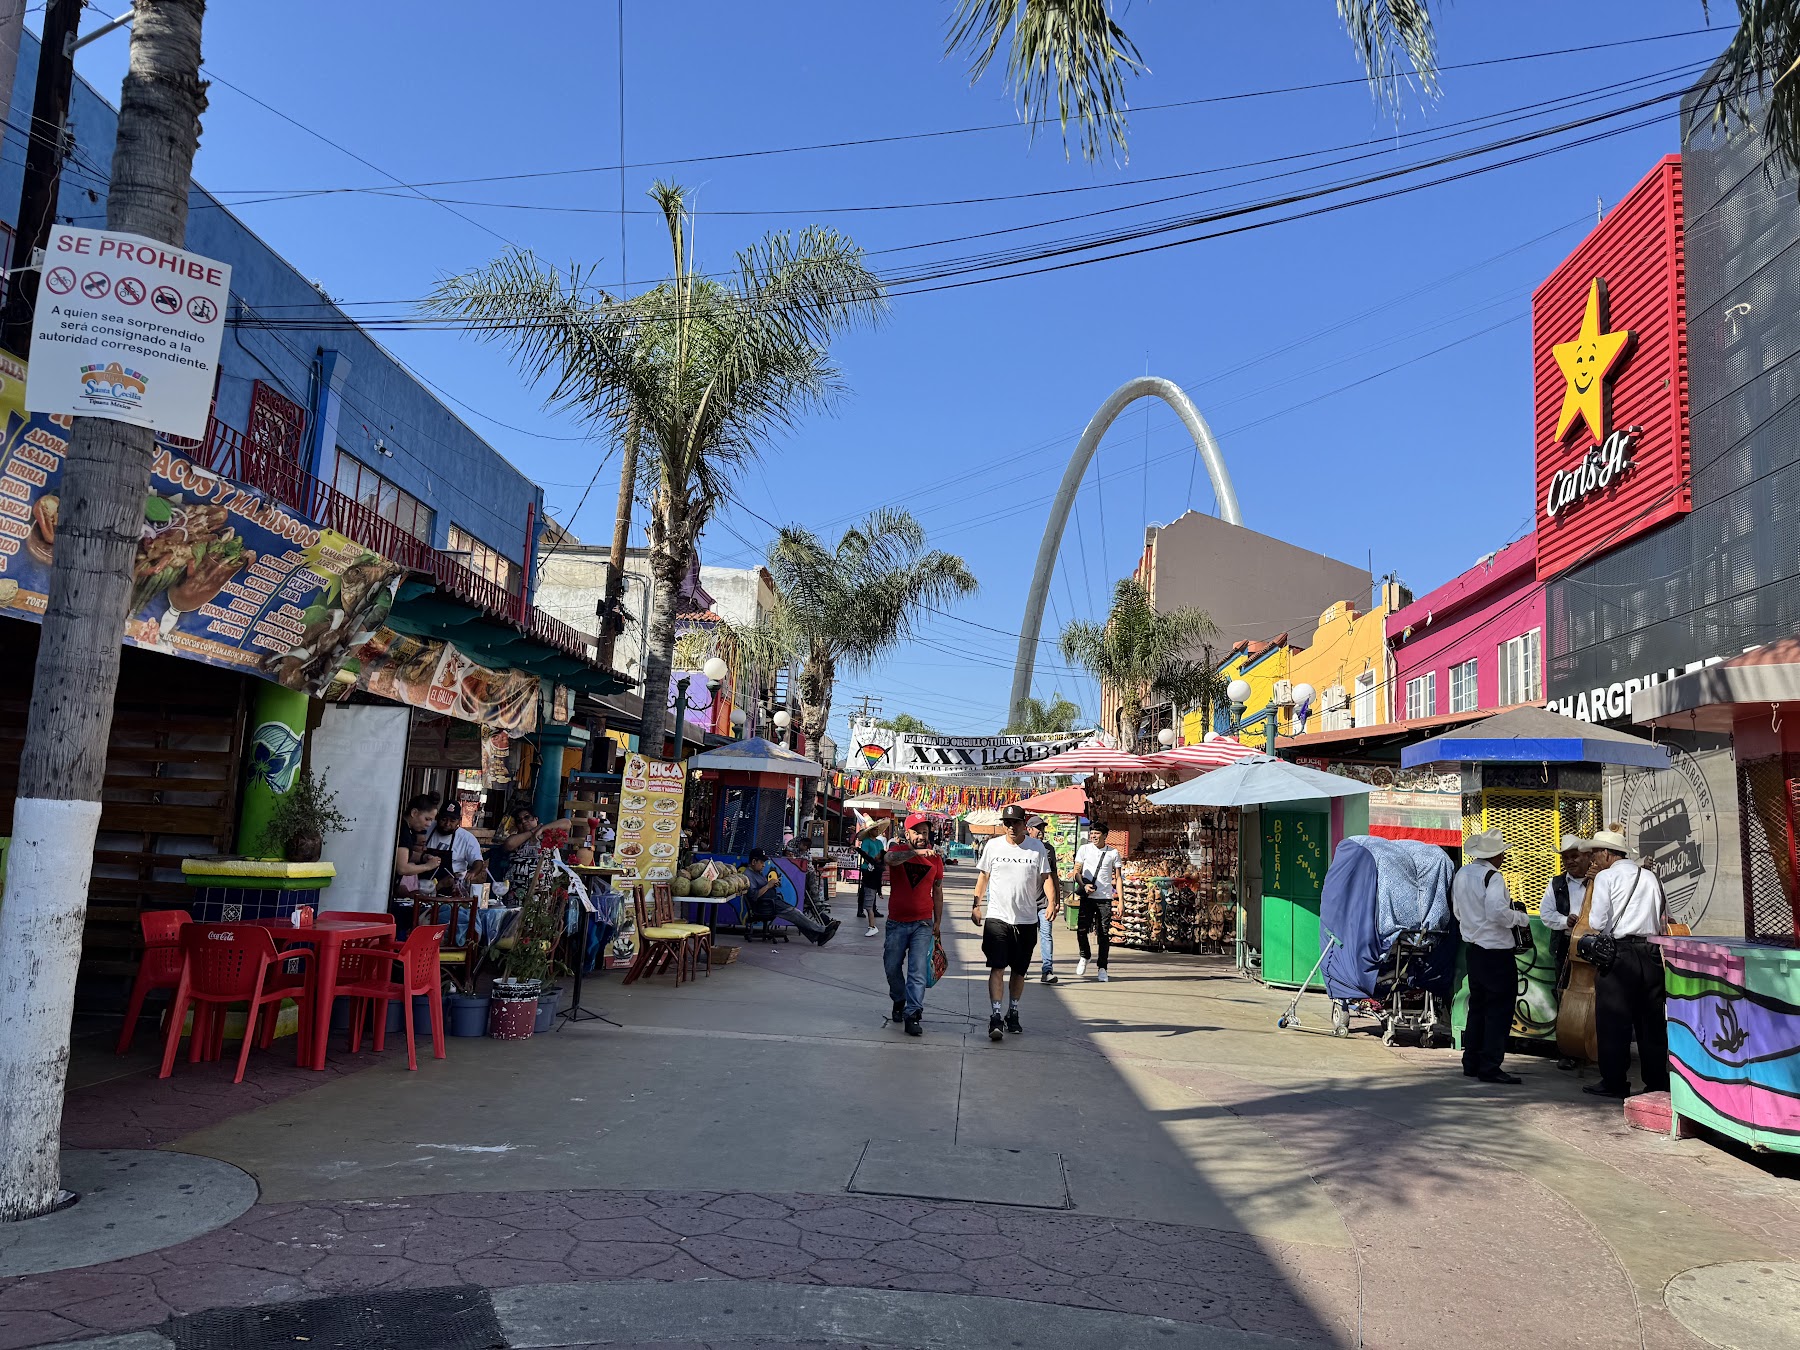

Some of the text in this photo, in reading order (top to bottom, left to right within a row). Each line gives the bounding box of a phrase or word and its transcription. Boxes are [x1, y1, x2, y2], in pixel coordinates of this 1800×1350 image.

[57, 235, 223, 287] SE PROHIBE
[51, 305, 205, 344] A quien sea sorprendido
[60, 319, 192, 353] será consignado a la
[38, 331, 209, 371] autoridad correspondiente.
[85, 379, 142, 401] Santa Cecilia
[15, 444, 57, 471] ASADA
[7, 461, 46, 486] BIRRIA
[1546, 429, 1629, 517] Carl's Jr.
[1, 478, 29, 500] TRIPA
[151, 446, 320, 548] ACOS Y MARISCOS
[260, 555, 293, 573] COCTELES
[283, 551, 304, 563] RICOS
[320, 546, 354, 565] CAMARONES
[250, 564, 284, 583] TOSTADAS
[299, 569, 329, 586] OSTIONES
[222, 582, 267, 604] AGUA CHILES
[245, 577, 275, 594] CEVICHE
[288, 578, 311, 592] PULPO
[25, 596, 48, 609] TORT
[280, 589, 300, 602] JAIBA
[230, 599, 259, 615] FILETES
[223, 611, 251, 626] CALDOS
[266, 612, 305, 633] MOJARRAS
[209, 621, 244, 638] AL GUSTO!
[255, 621, 301, 645] PREPARADAS
[253, 636, 289, 654] AL GUSTO!
[430, 689, 438, 701] EL
[904, 735, 937, 746] MARCHA
[939, 737, 949, 746] DE
[950, 738, 988, 747] ORGULLO
[988, 736, 1022, 747] TIJUANA
[911, 746, 976, 765] XXX
[649, 761, 684, 779] RICA
[1681, 757, 1709, 809] BURGERS
[1297, 821, 1320, 857] SHOE
[1274, 819, 1282, 889] BOLERIA
[1296, 855, 1319, 888] SHINE
